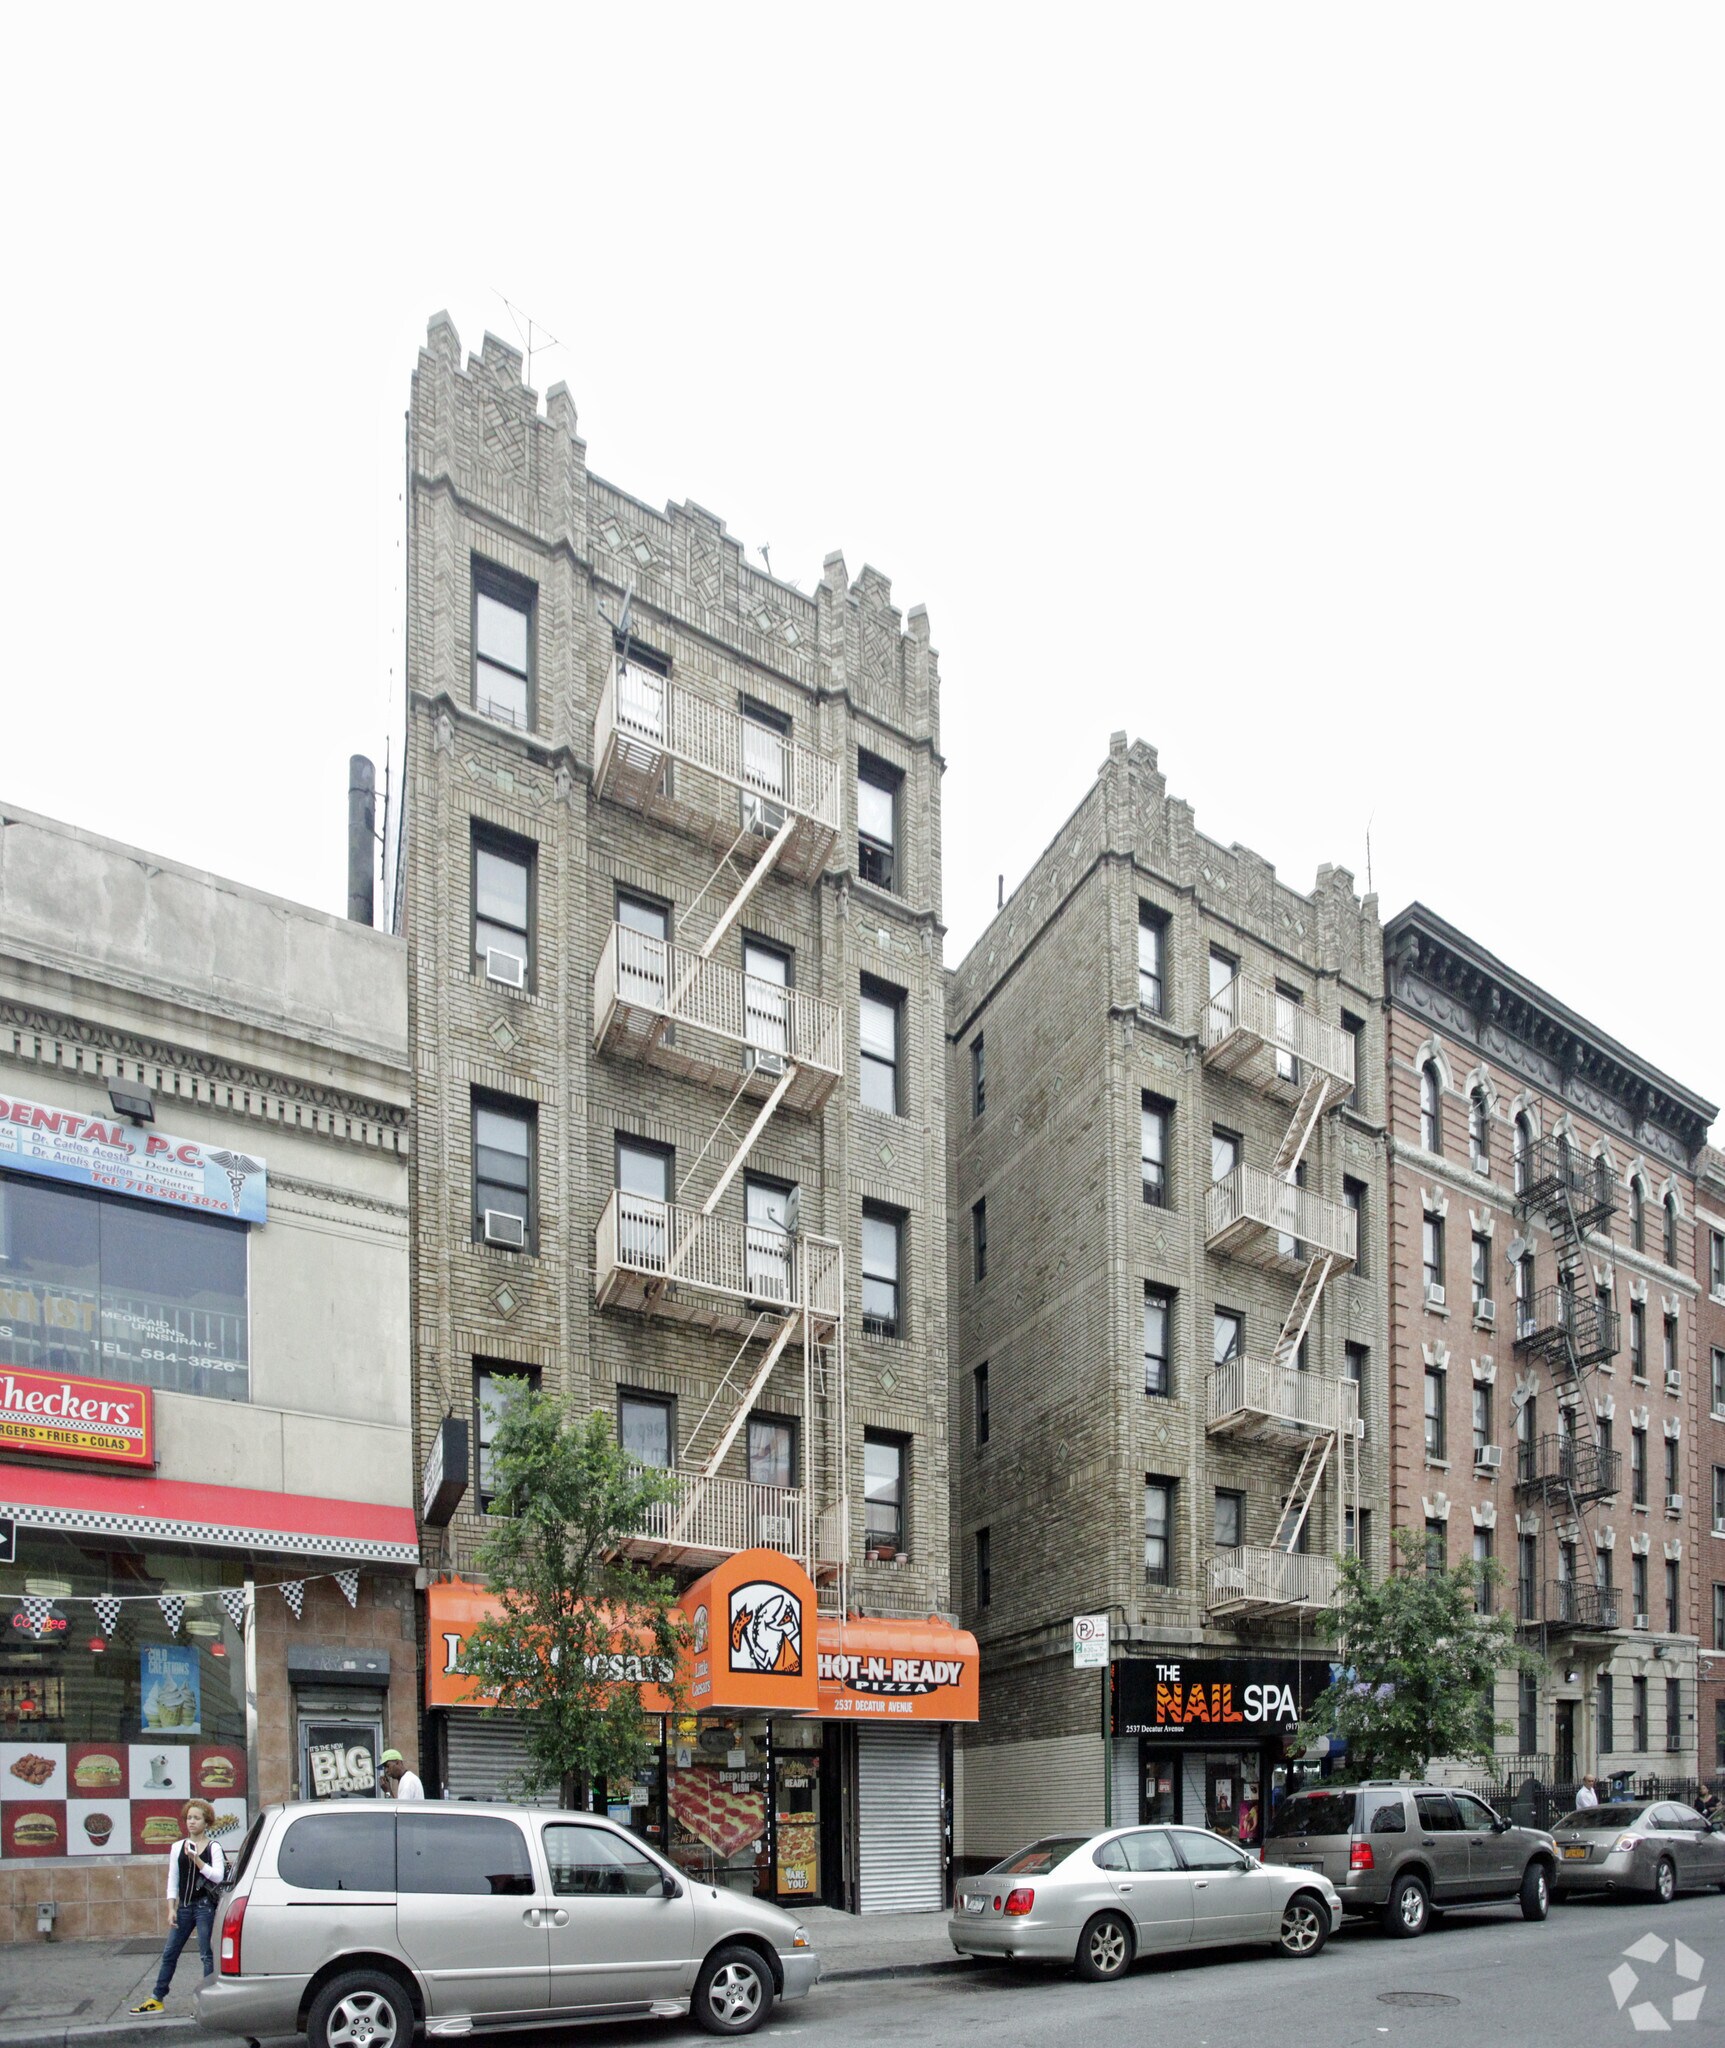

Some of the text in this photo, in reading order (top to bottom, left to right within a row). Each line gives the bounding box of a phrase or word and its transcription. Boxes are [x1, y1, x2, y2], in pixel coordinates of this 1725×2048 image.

[32, 1132, 195, 1178] Dr. Carlos Acosta Dentista
[145, 1135, 205, 1168] P.C.
[32, 1146, 48, 1158] Dr.
[93, 1160, 133, 1176] Grullon
[145, 1174, 195, 1191] Pediatra
[125, 1180, 229, 1210] 718.584.3826
[101, 1310, 169, 1328] MEDICAID
[131, 1322, 185, 1337] UNIONS
[90, 1340, 236, 1373] TEL. 584-3826
[47, 1430, 79, 1443] FRIES
[90, 1436, 125, 1450] COLAS
[694, 1660, 708, 1678] Little
[817, 1653, 964, 1687] HOT-N-READY
[1156, 1664, 1180, 1681] THE
[691, 1680, 711, 1697] Caesars
[856, 1681, 928, 1692] PIZZA
[834, 1699, 913, 1713] 2537 DECATUR AVENUE
[1156, 1683, 1243, 1723] NAIL
[1244, 1684, 1298, 1723] SPA
[1126, 1725, 1140, 1733] 2537
[1141, 1725, 1163, 1733] Decatur
[311, 1746, 374, 1781] BIG
[680, 1749, 689, 1761] A
[316, 1775, 375, 1796] BUFORD
[719, 1771, 761, 1783] DEEP! DEEP!
[784, 1779, 809, 1788] READY!
[732, 1782, 750, 1794] DISH
[790, 1870, 806, 1879] ARE
[787, 1879, 808, 1889] YOU?
